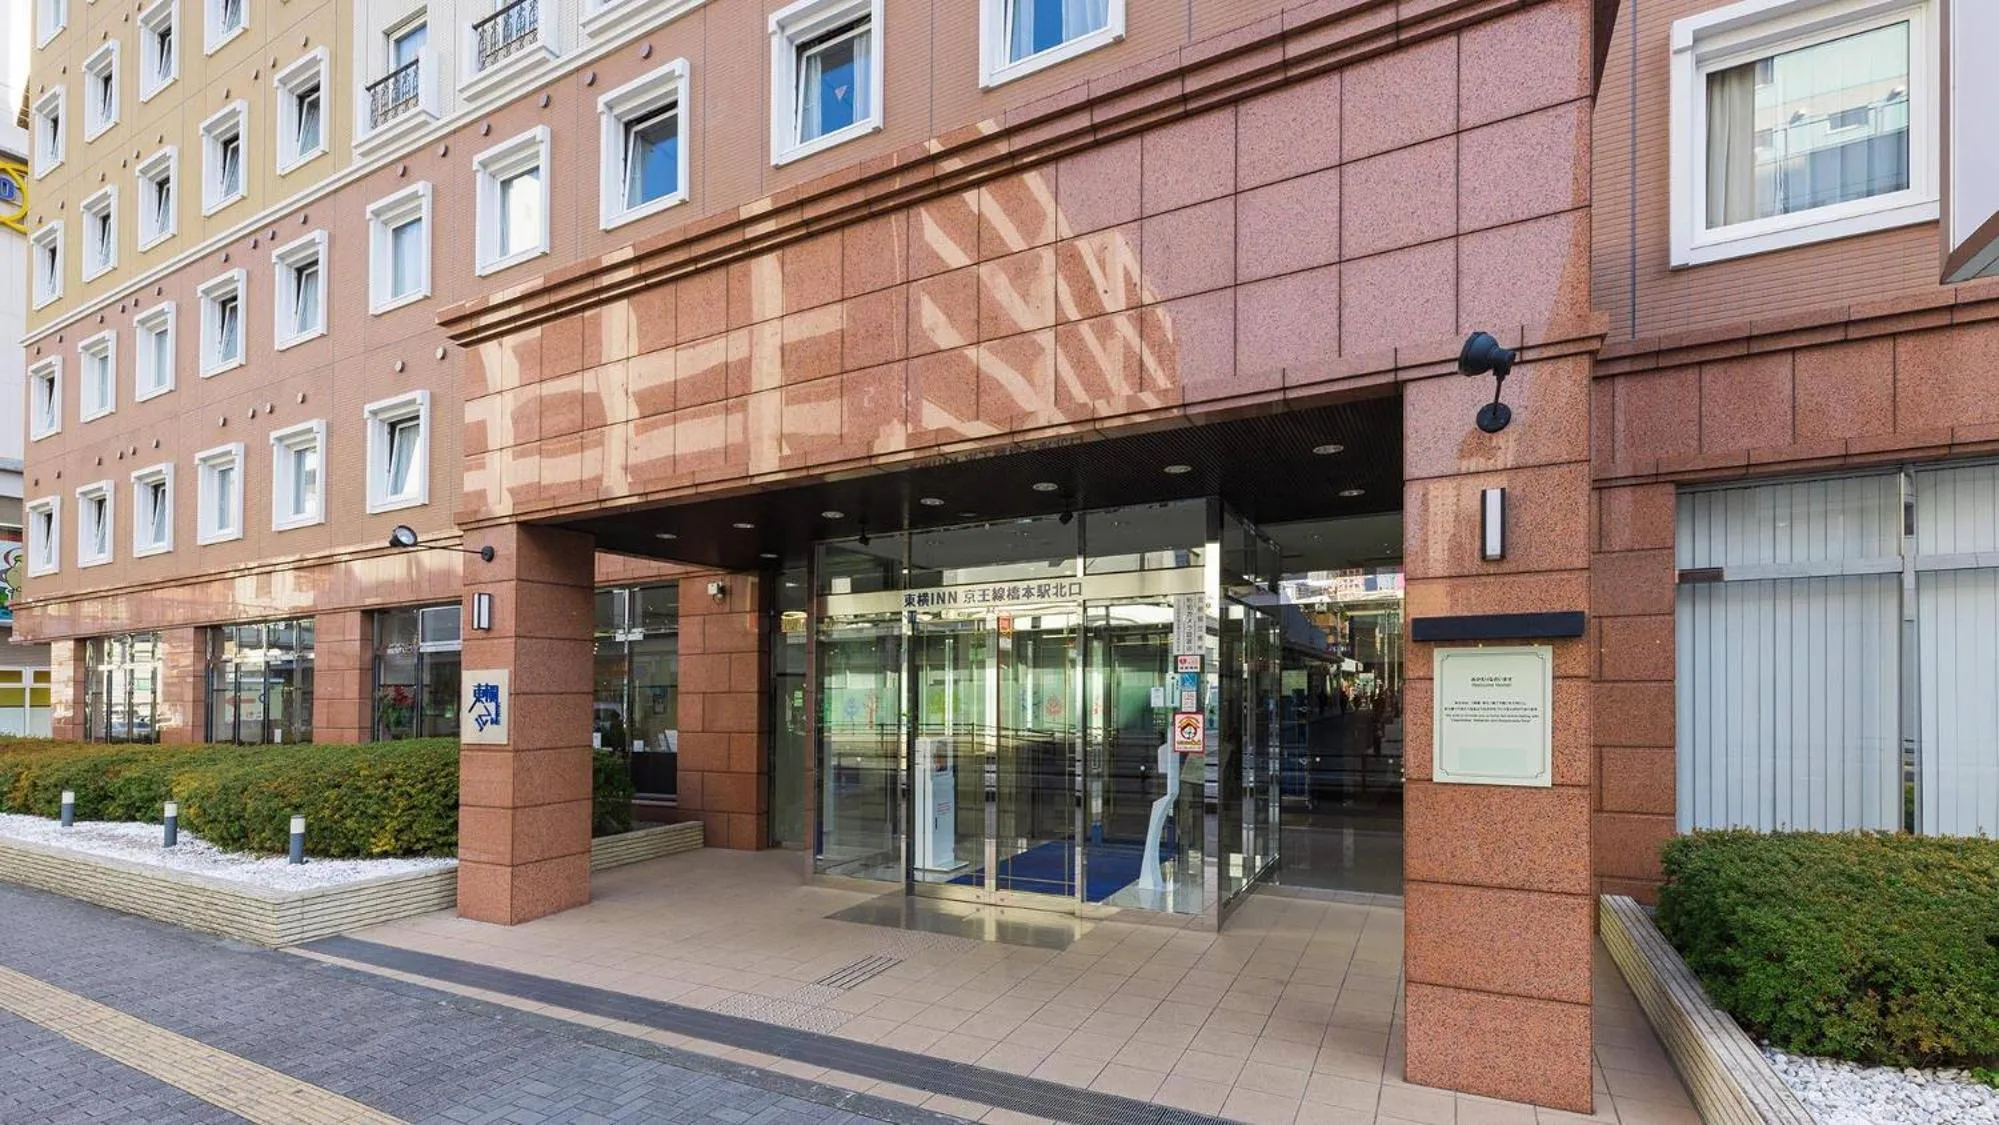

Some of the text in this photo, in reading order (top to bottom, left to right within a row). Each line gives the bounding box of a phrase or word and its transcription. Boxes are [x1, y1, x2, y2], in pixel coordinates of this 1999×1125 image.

[904, 582, 1082, 608] 東横INN 京王線橋本駅北口
